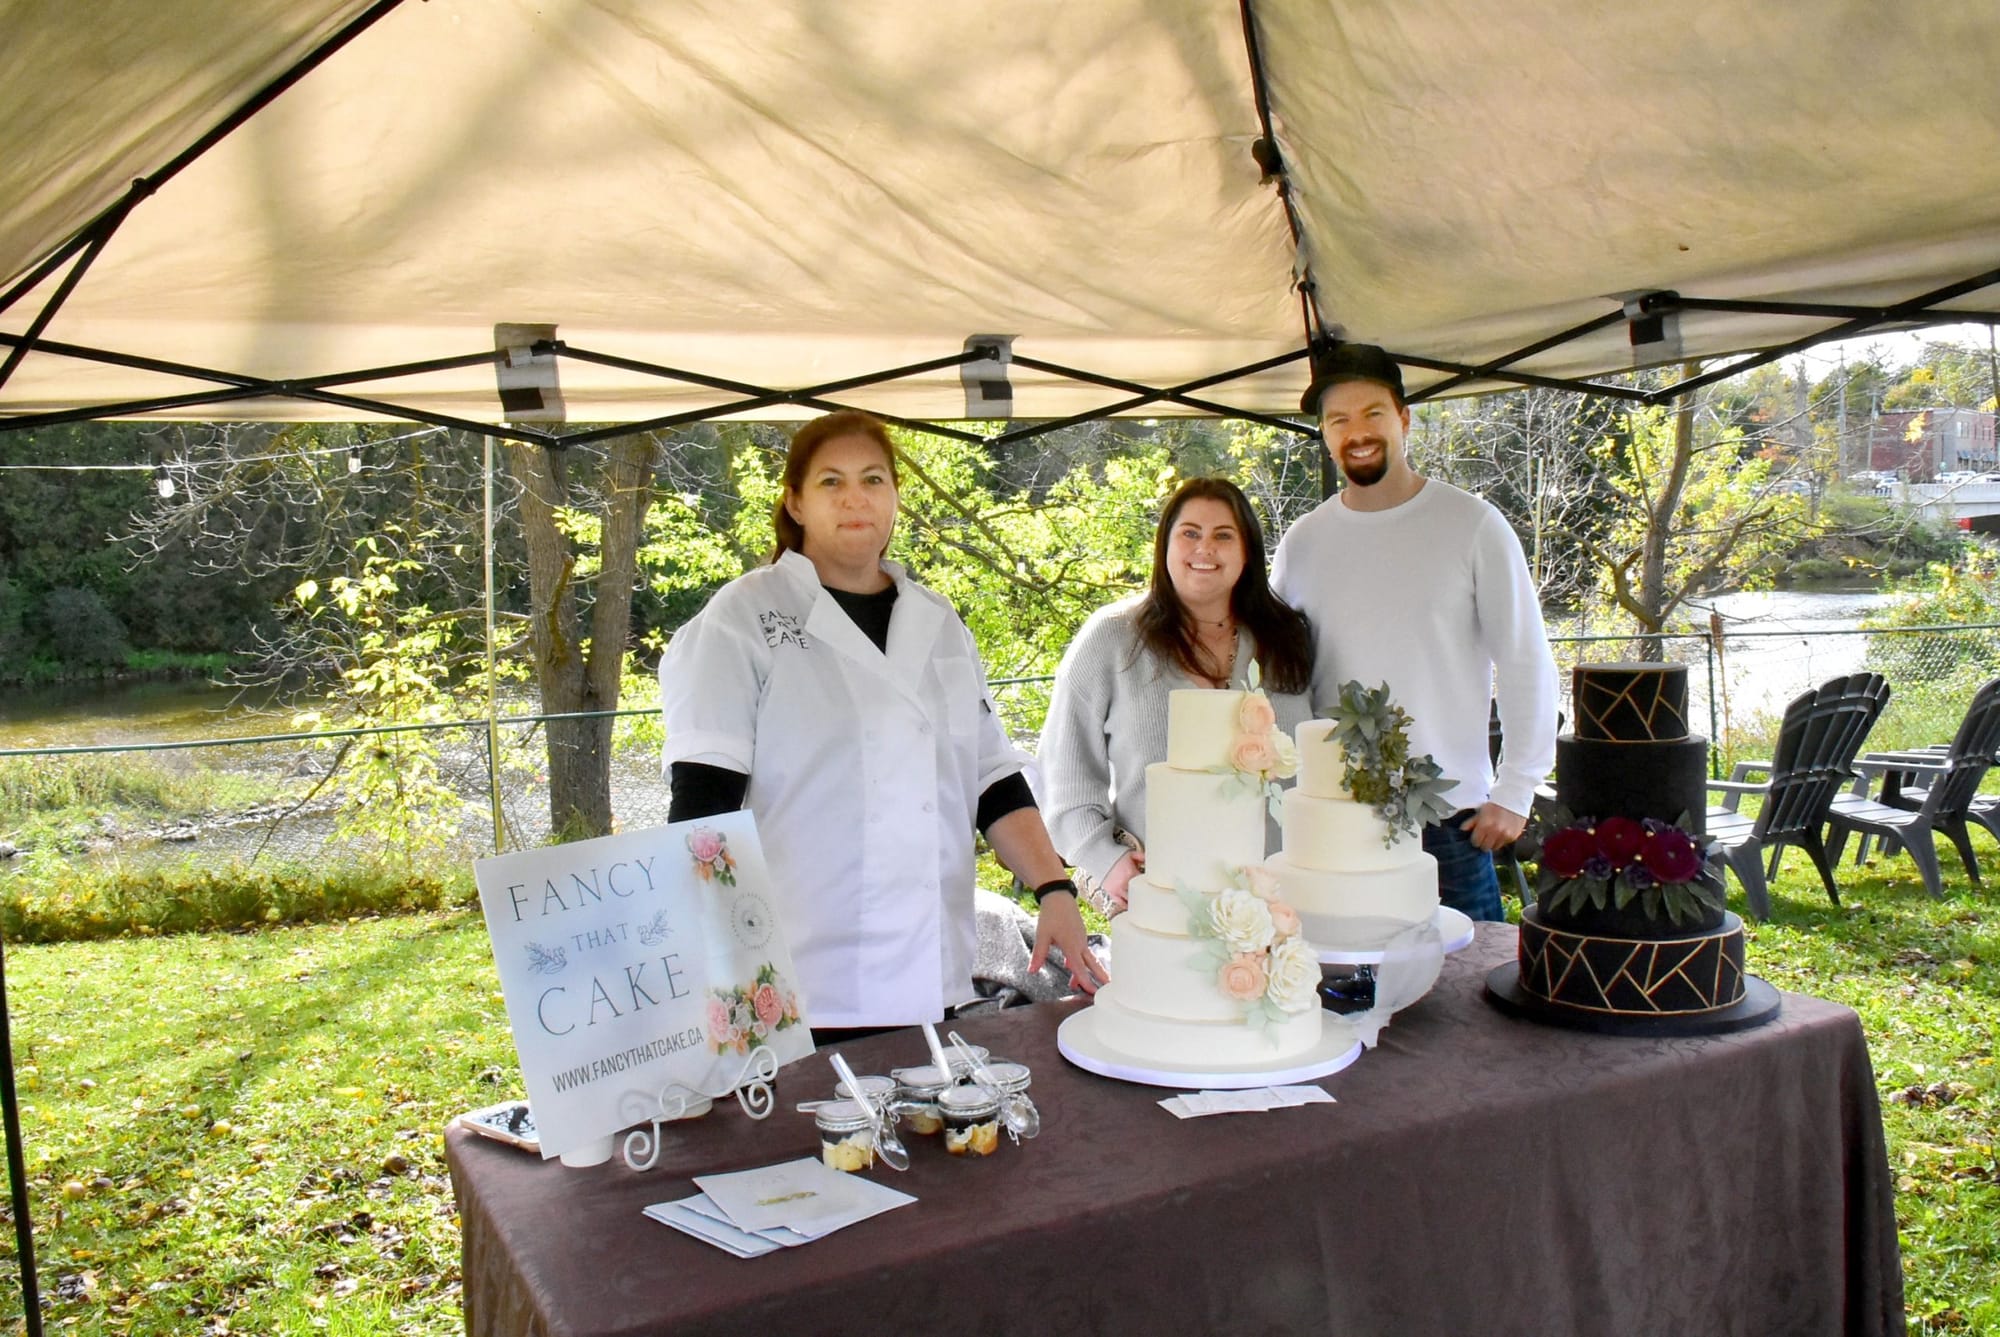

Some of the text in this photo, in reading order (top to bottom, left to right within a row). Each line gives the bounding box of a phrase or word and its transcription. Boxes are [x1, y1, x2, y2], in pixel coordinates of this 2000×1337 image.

[759, 609, 797, 625] FAY
[507, 855, 657, 922] FANCY
[571, 922, 630, 952] THAT
[537, 952, 691, 1037] CAKE
[552, 1026, 705, 1094] WWW.FANCYTHATCAKE.CA
